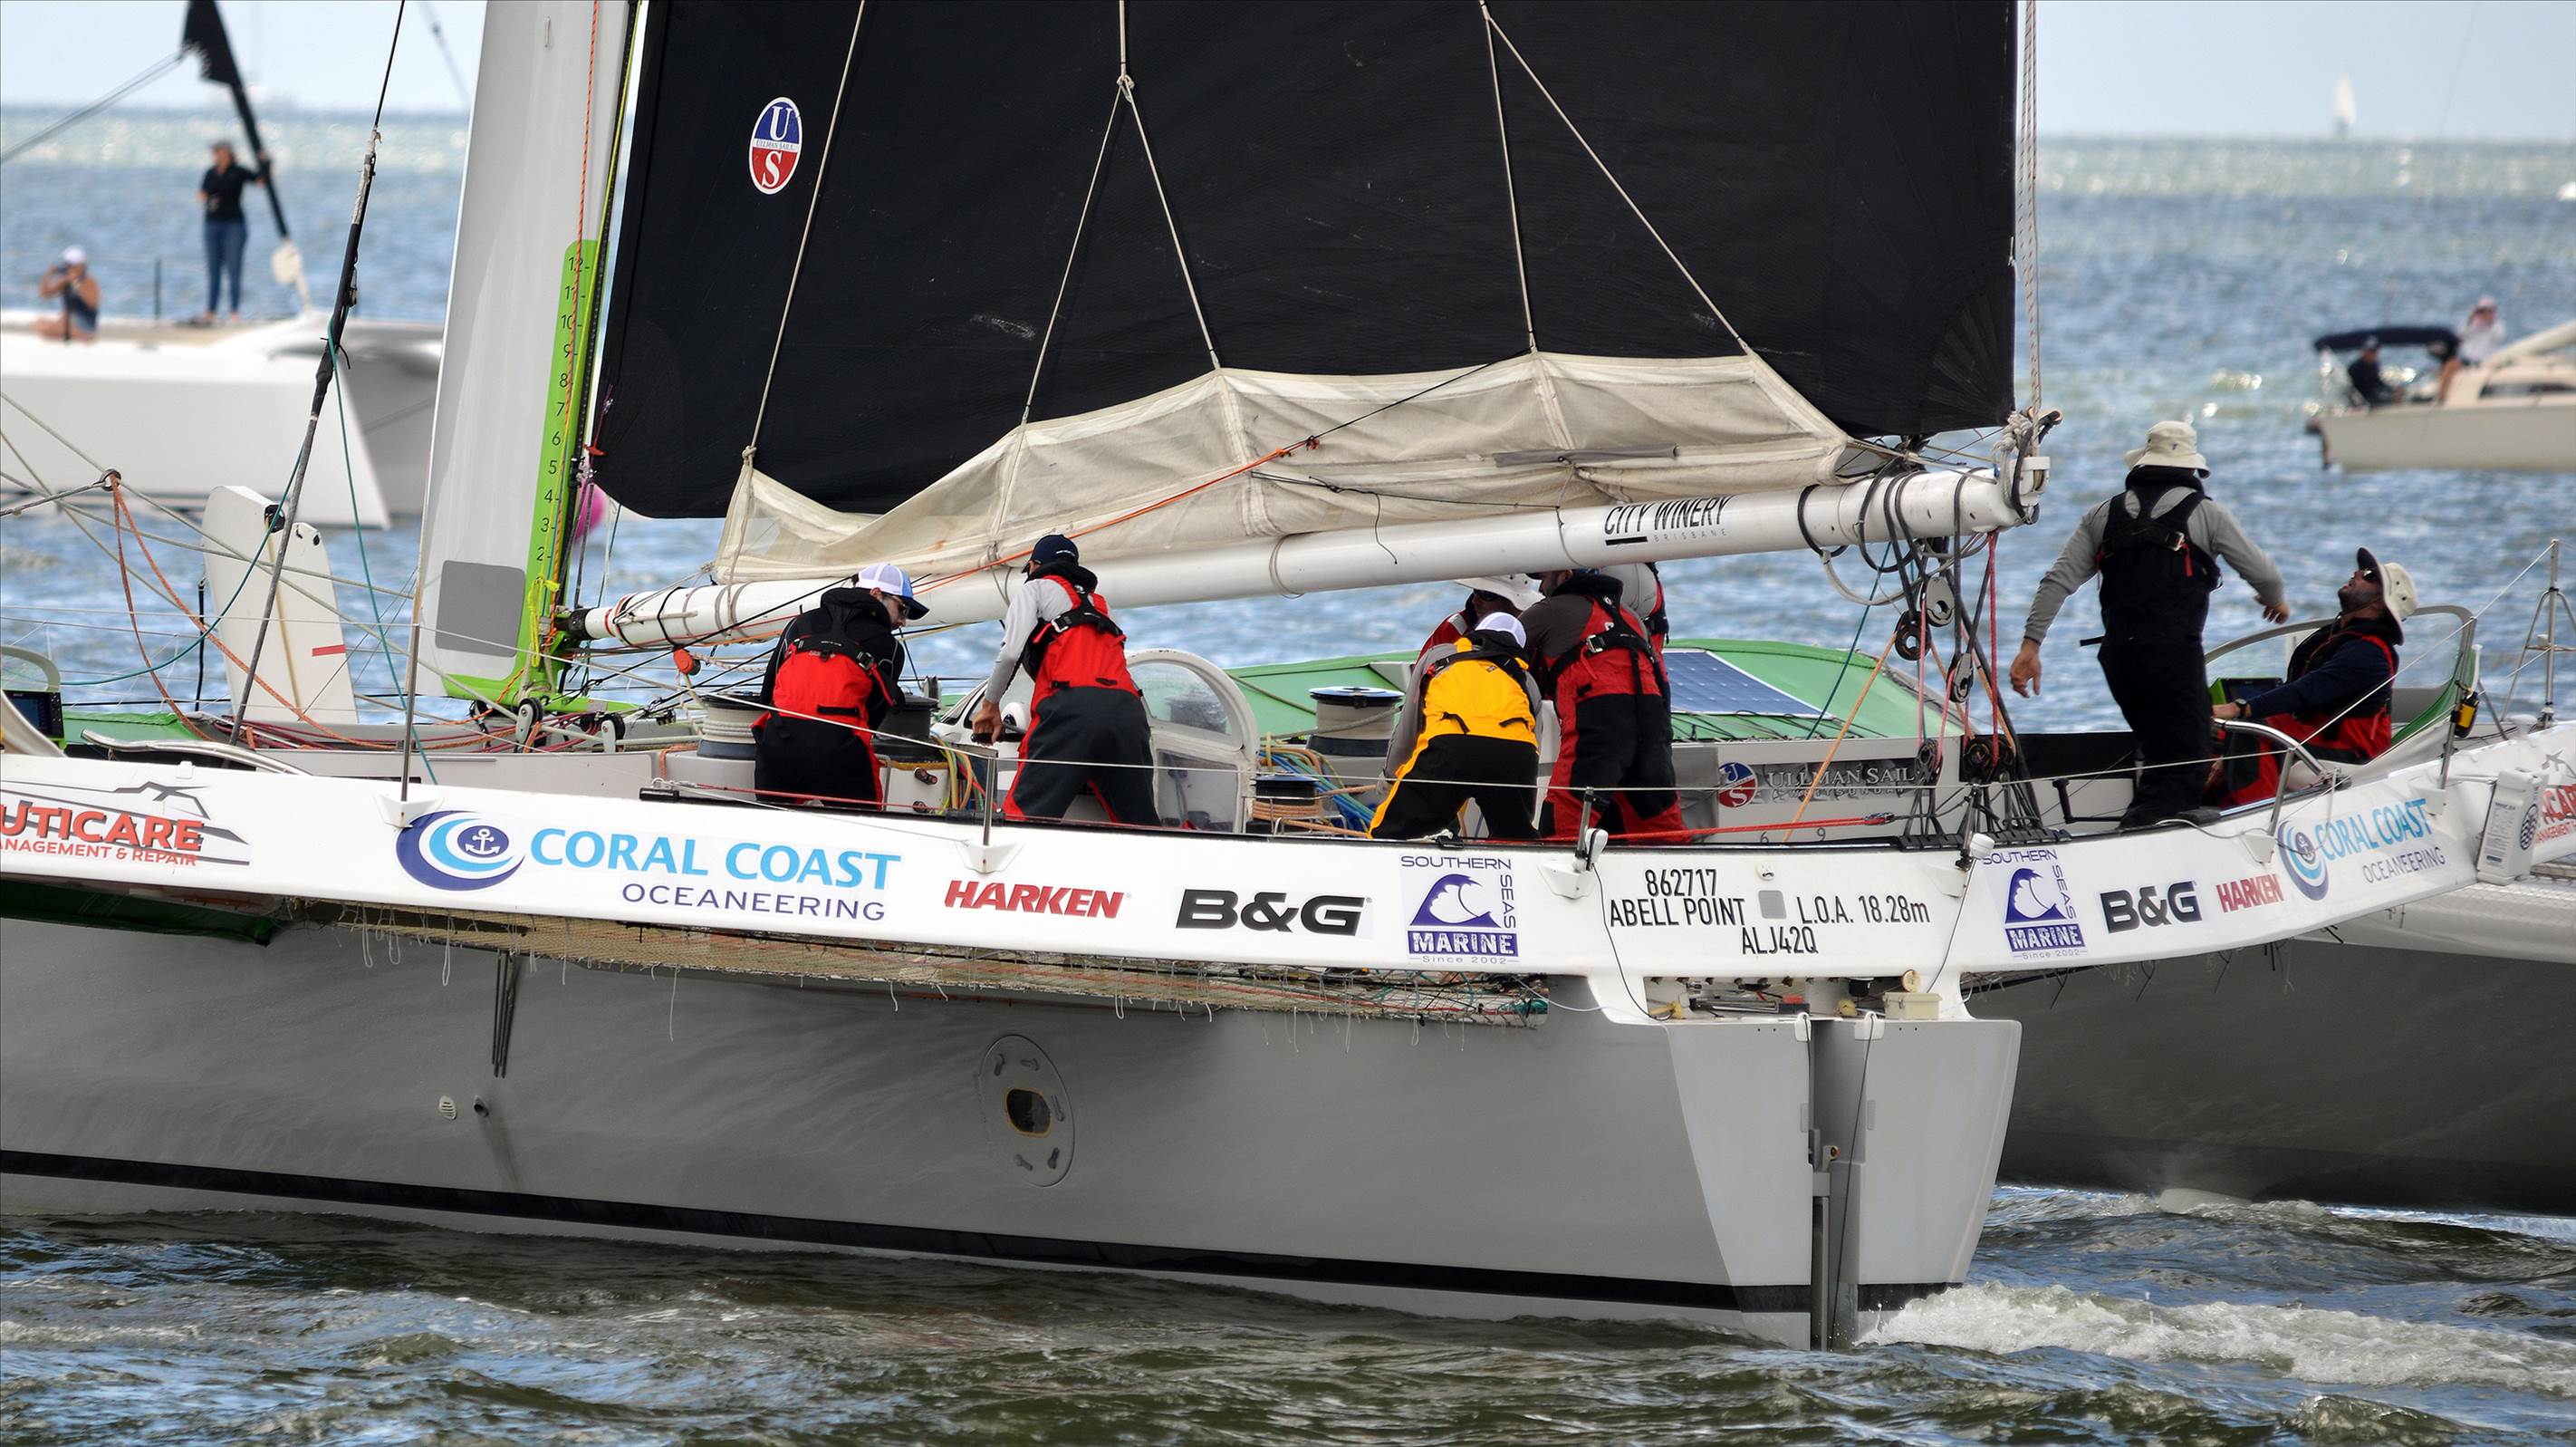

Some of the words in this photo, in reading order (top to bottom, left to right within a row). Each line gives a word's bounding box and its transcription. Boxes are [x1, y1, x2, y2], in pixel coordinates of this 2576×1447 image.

[769, 105, 794, 141] U
[761, 150, 783, 188] S
[559, 372, 568, 388] 8
[557, 401, 565, 416] 7
[552, 430, 562, 446] 6
[548, 459, 558, 475] 5
[543, 489, 553, 503] 4
[540, 517, 550, 533] 3
[1604, 502, 1656, 535] CITY
[1654, 495, 1737, 531] WINERY
[1653, 528, 1727, 543] BRISBANE
[536, 546, 545, 562] 2
[1767, 769, 1860, 788] ULLMAN
[1729, 786, 1747, 808] S
[1816, 827, 1826, 842] 9
[2314, 812, 2379, 862] CORAL
[2371, 797, 2433, 845] COAST
[0, 838, 112, 858] NAGEMENT
[115, 847, 128, 861] &
[132, 851, 198, 867] REPAIR
[530, 827, 708, 876] CORAL
[726, 842, 902, 891] COAST
[1400, 855, 1512, 870] SOUTHERN
[1983, 849, 2058, 865] SOUTHERN
[2362, 846, 2446, 884] OCEANEERING
[1644, 868, 1717, 897] 862717
[2052, 864, 2077, 920] SEAS
[2216, 873, 2284, 914] HARKEN
[621, 883, 886, 921] OCEANEERING
[944, 880, 1125, 919] HARKEN
[1176, 889, 1366, 937] B&G
[1500, 874, 1516, 929] SEAS
[1610, 898, 1679, 927] ABELL
[1685, 897, 1746, 926] POINT
[1796, 895, 1854, 924] L.O.A.
[1858, 894, 1931, 923] 18.28m
[2100, 881, 2203, 934] B&G
[1412, 931, 1514, 955] MARINE
[1741, 926, 1819, 955] ALJ42Q
[2009, 925, 2082, 950] MARINE
[1471, 956, 1506, 964] 2002
[2022, 950, 2052, 960] Since
[2056, 949, 2081, 957] 2002
